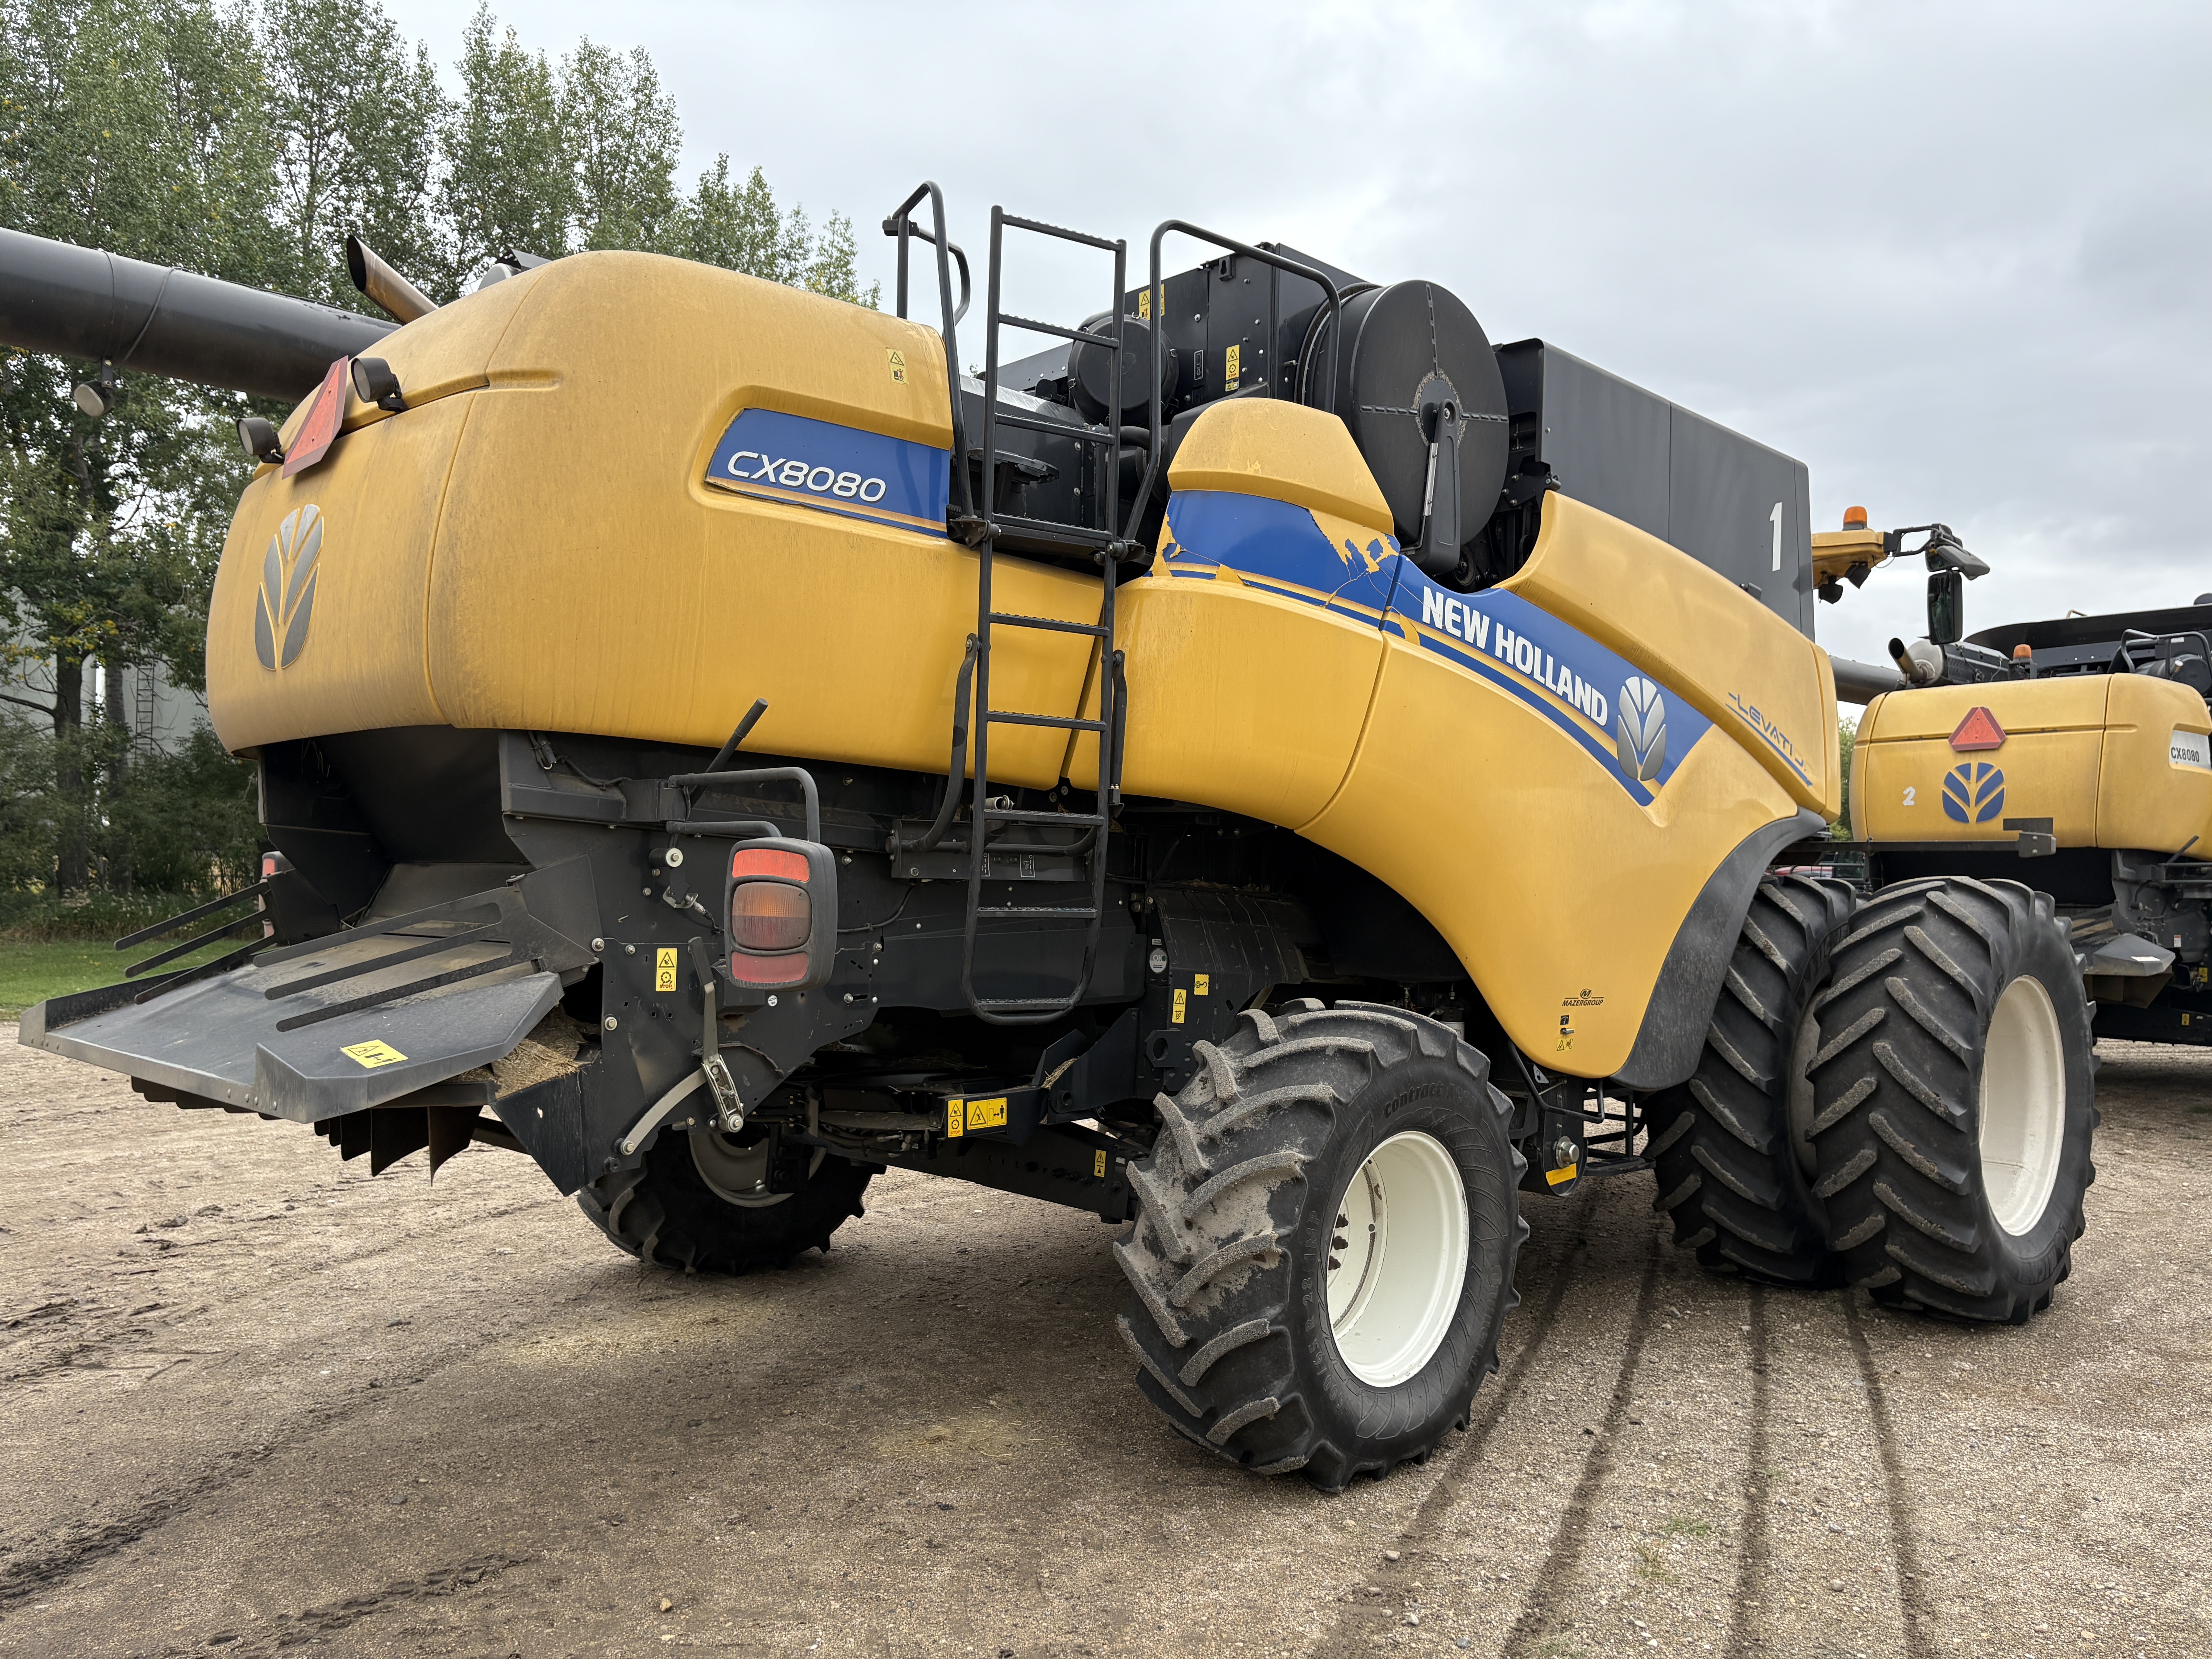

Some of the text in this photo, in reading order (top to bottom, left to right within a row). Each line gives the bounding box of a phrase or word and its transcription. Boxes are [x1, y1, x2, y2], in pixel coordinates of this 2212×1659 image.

[727, 451, 886, 502] CX8080
[1769, 502, 1782, 571] 1
[1422, 586, 1608, 727] NEW HOLLAND
[2171, 747, 2200, 763] CX8080
[1902, 786, 1916, 806] 2
[1561, 999, 1604, 1007] MAZERGROUP
